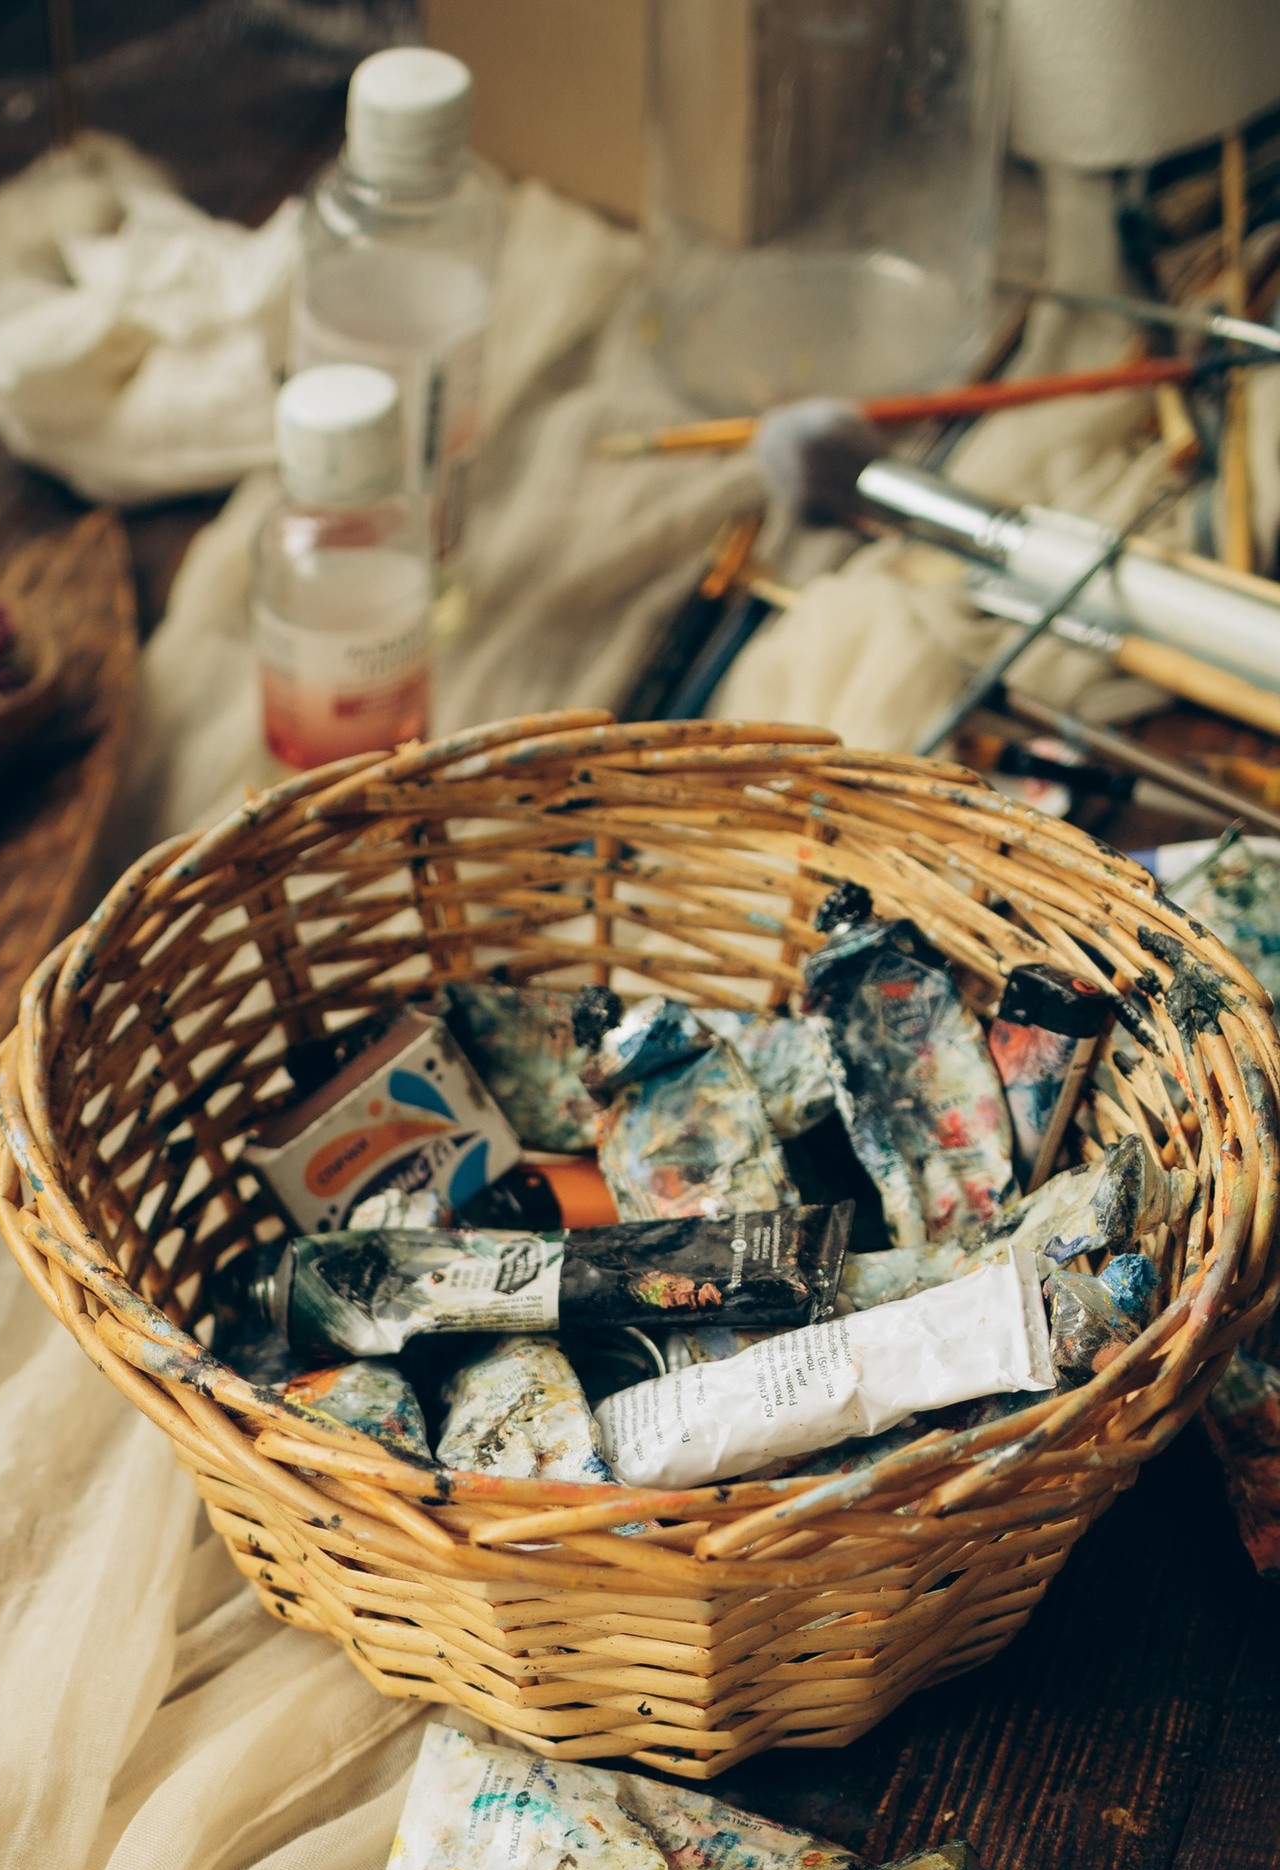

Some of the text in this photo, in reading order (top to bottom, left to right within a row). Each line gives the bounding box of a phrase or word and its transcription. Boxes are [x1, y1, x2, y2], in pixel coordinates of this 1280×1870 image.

[794, 1367, 807, 1387] дом
[815, 1355, 831, 1379] (495)
[823, 1379, 835, 1398] тел.
[762, 1402, 775, 1418] АО
[507, 1810, 523, 1861] PALITRA
